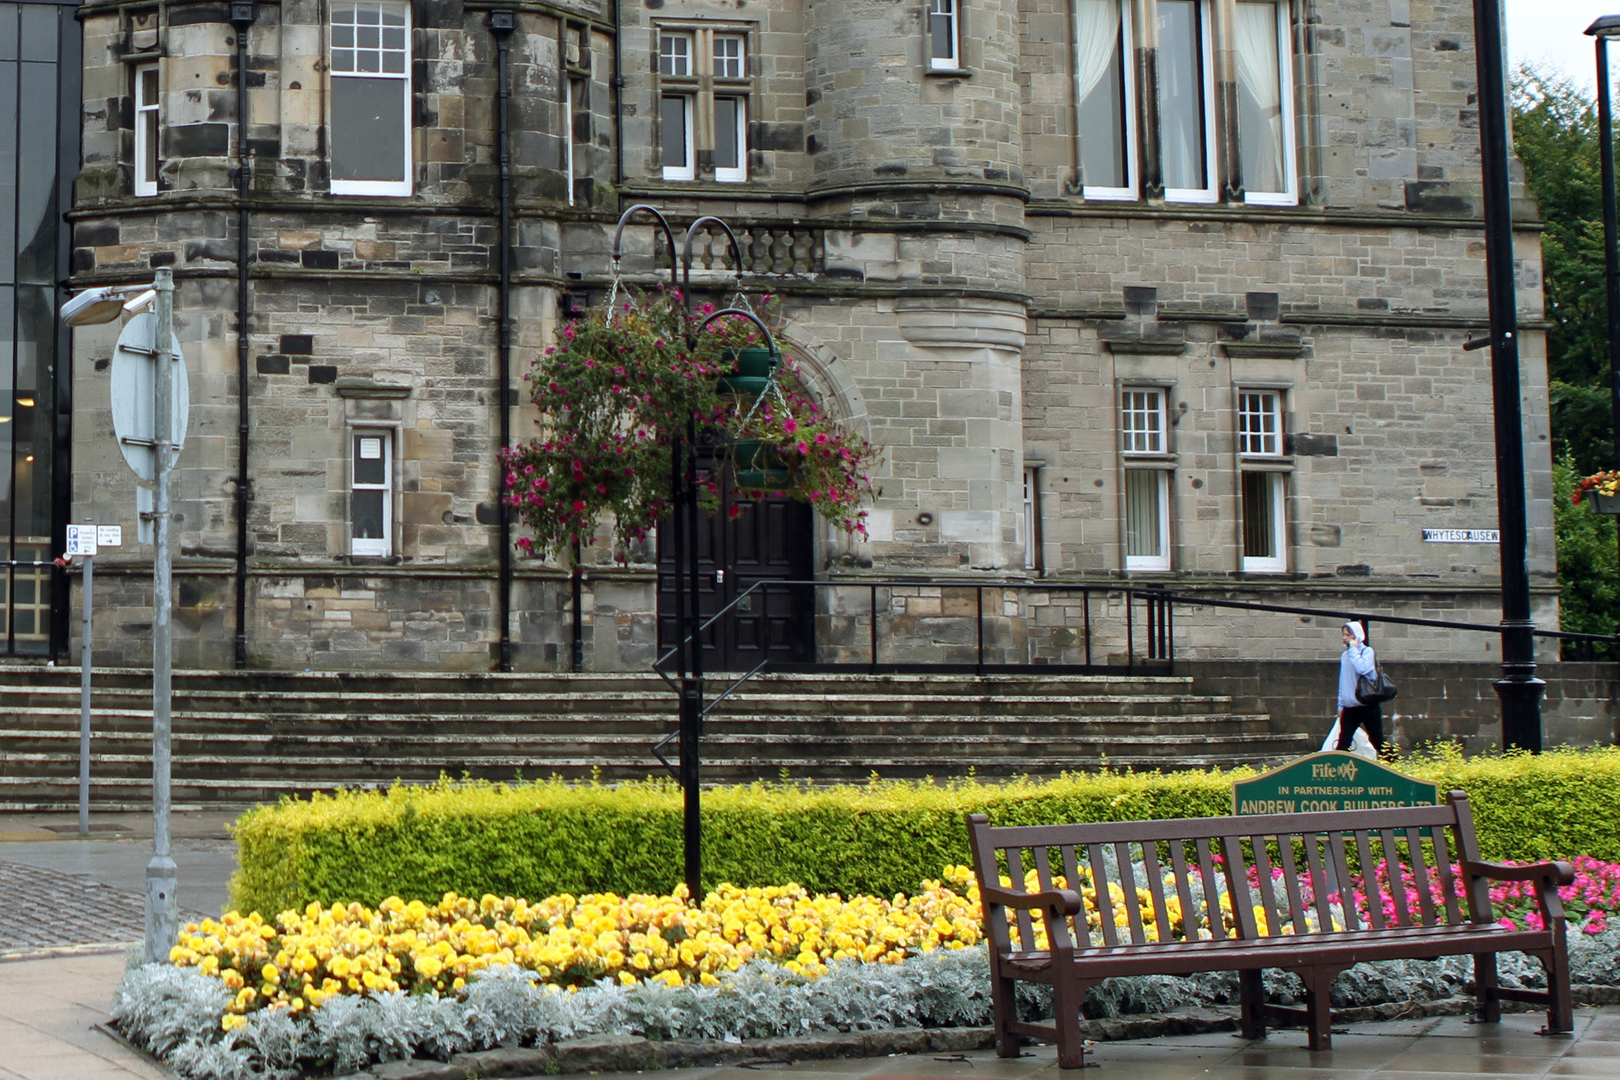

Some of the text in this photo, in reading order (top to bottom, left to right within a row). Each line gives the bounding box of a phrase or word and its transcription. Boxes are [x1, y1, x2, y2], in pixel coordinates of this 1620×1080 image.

[1424, 530, 1499, 540] WHYTESCAUSEW
[1311, 763, 1337, 778] Fife
[1278, 786, 1394, 796] IN PARTNERSHIP WITH
[1240, 800, 1296, 814] ANDREW
[1300, 800, 1338, 813] COOK
